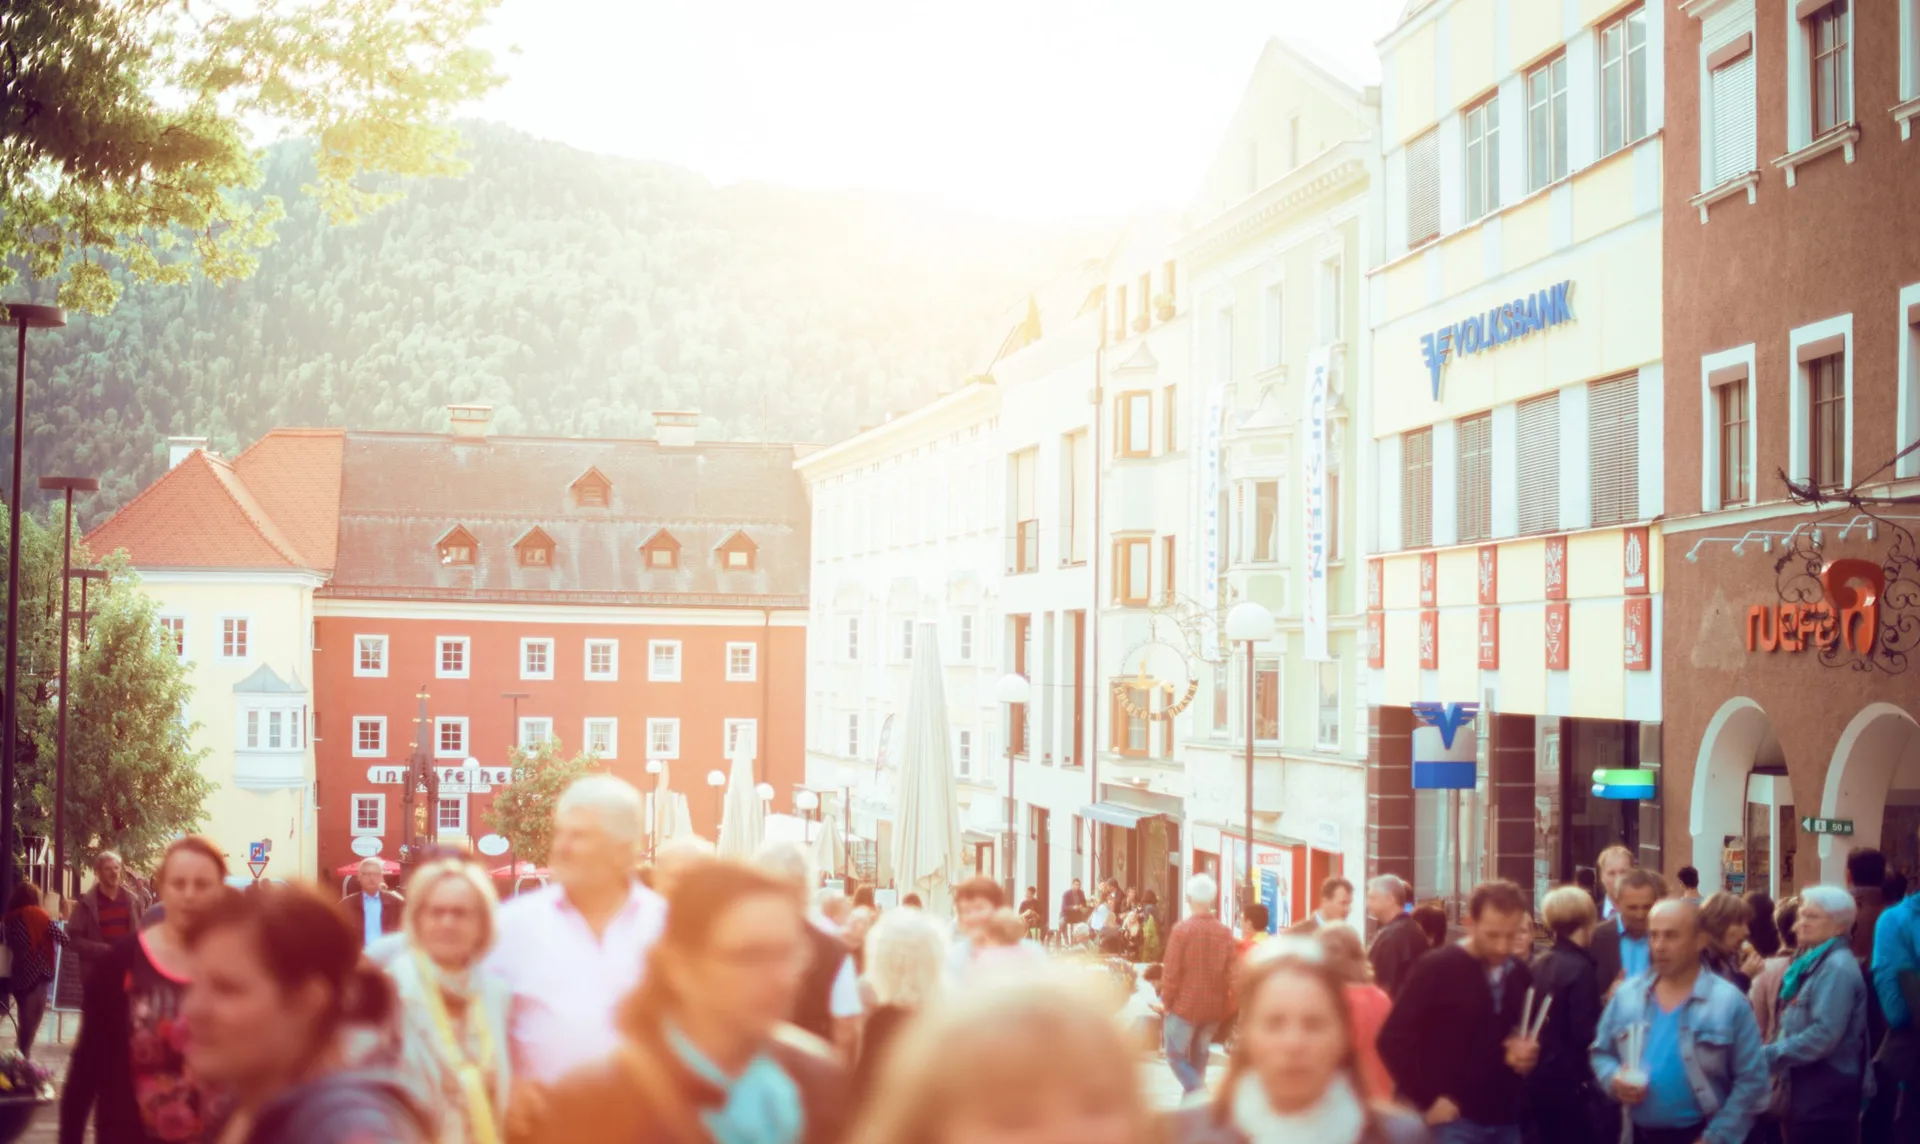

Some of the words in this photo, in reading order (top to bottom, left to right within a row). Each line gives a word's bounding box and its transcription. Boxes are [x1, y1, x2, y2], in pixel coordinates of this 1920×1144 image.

[1452, 280, 1572, 357] VOLKSBANK
[1311, 366, 1325, 578] KUFSTEIN
[1747, 604, 1839, 653] ruefa
[1832, 823, 1842, 831] 50
